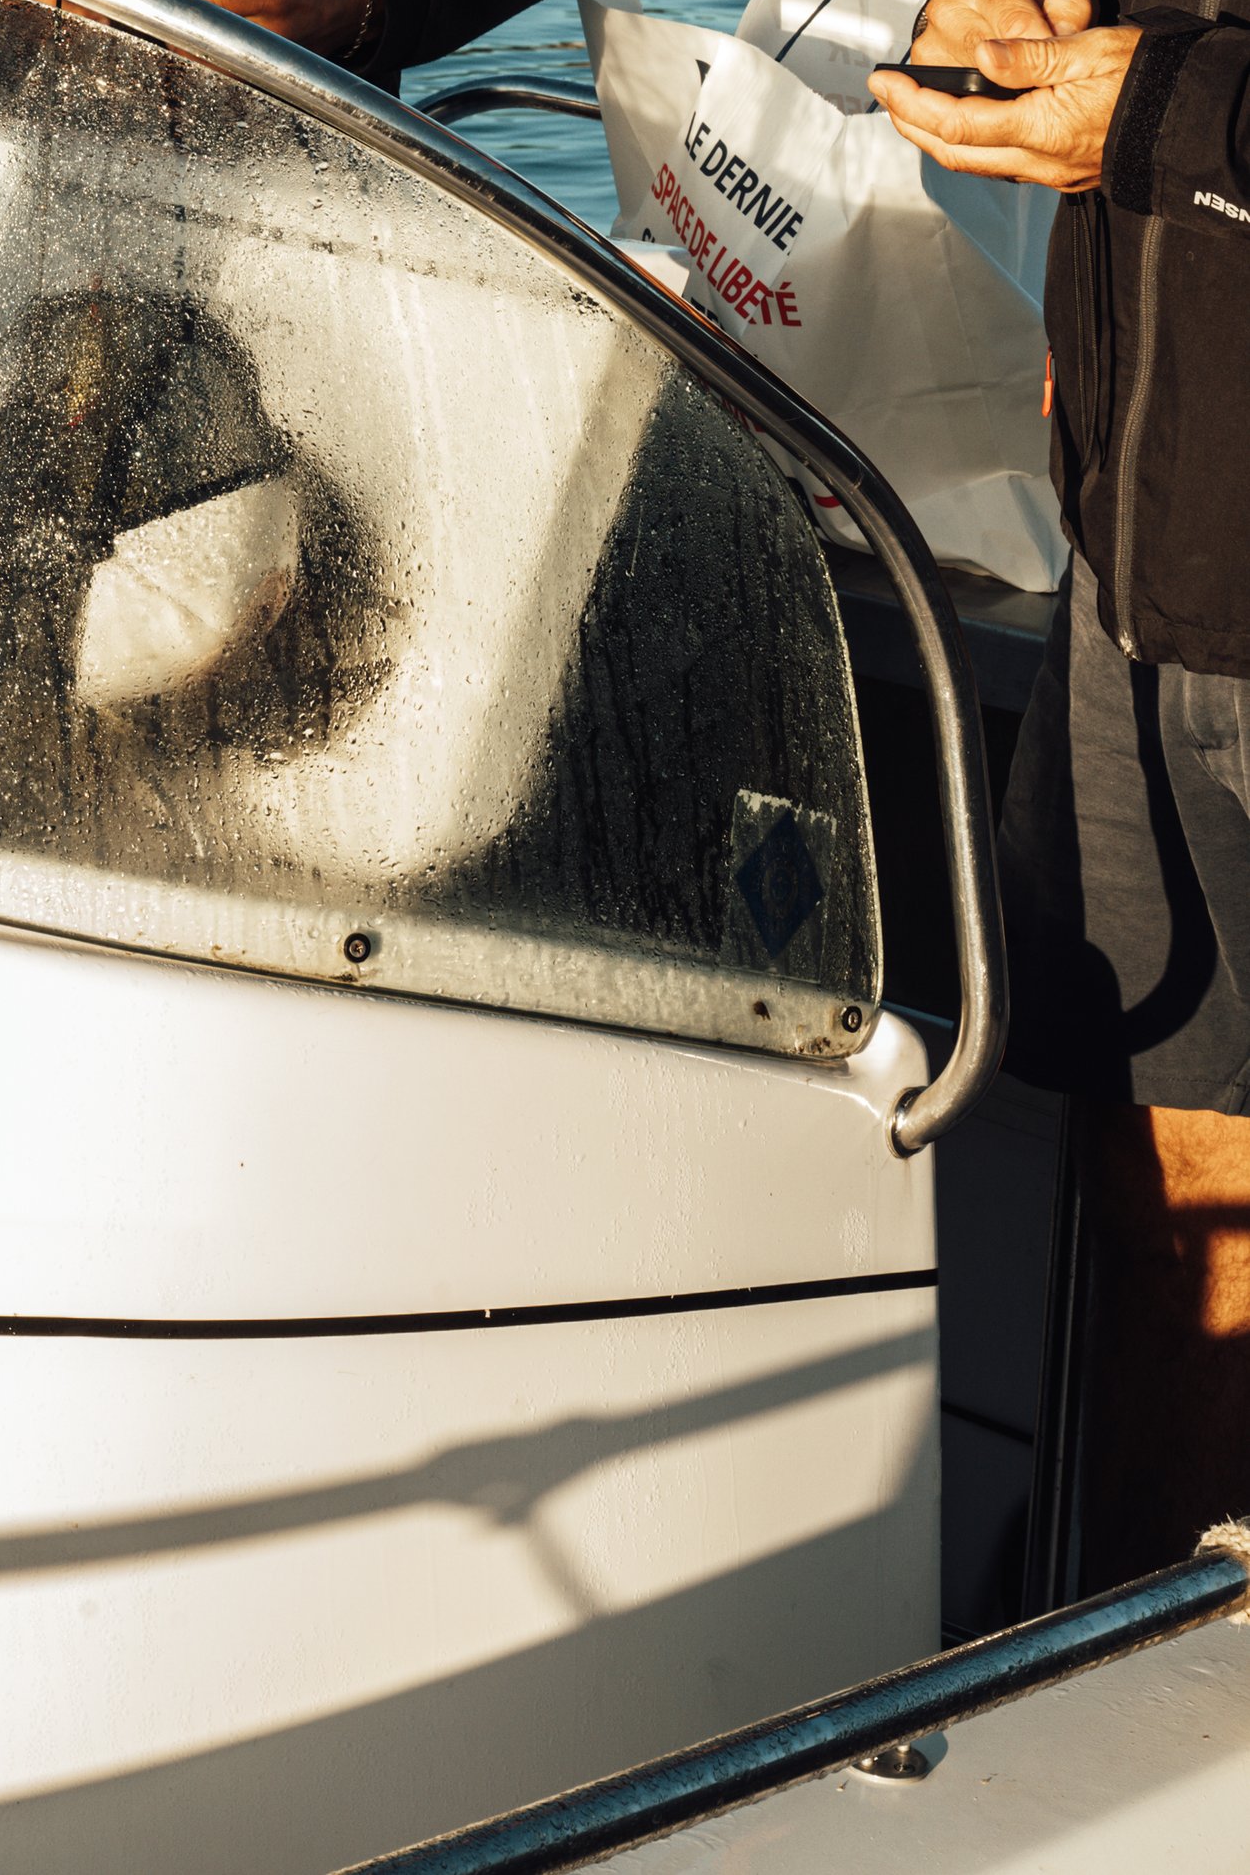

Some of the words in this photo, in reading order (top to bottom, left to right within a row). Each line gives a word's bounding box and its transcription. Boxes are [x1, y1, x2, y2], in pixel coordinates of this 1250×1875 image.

[651, 163, 696, 245] SPACE
[688, 216, 718, 272] DE
[699, 139, 804, 256] DERNIE
